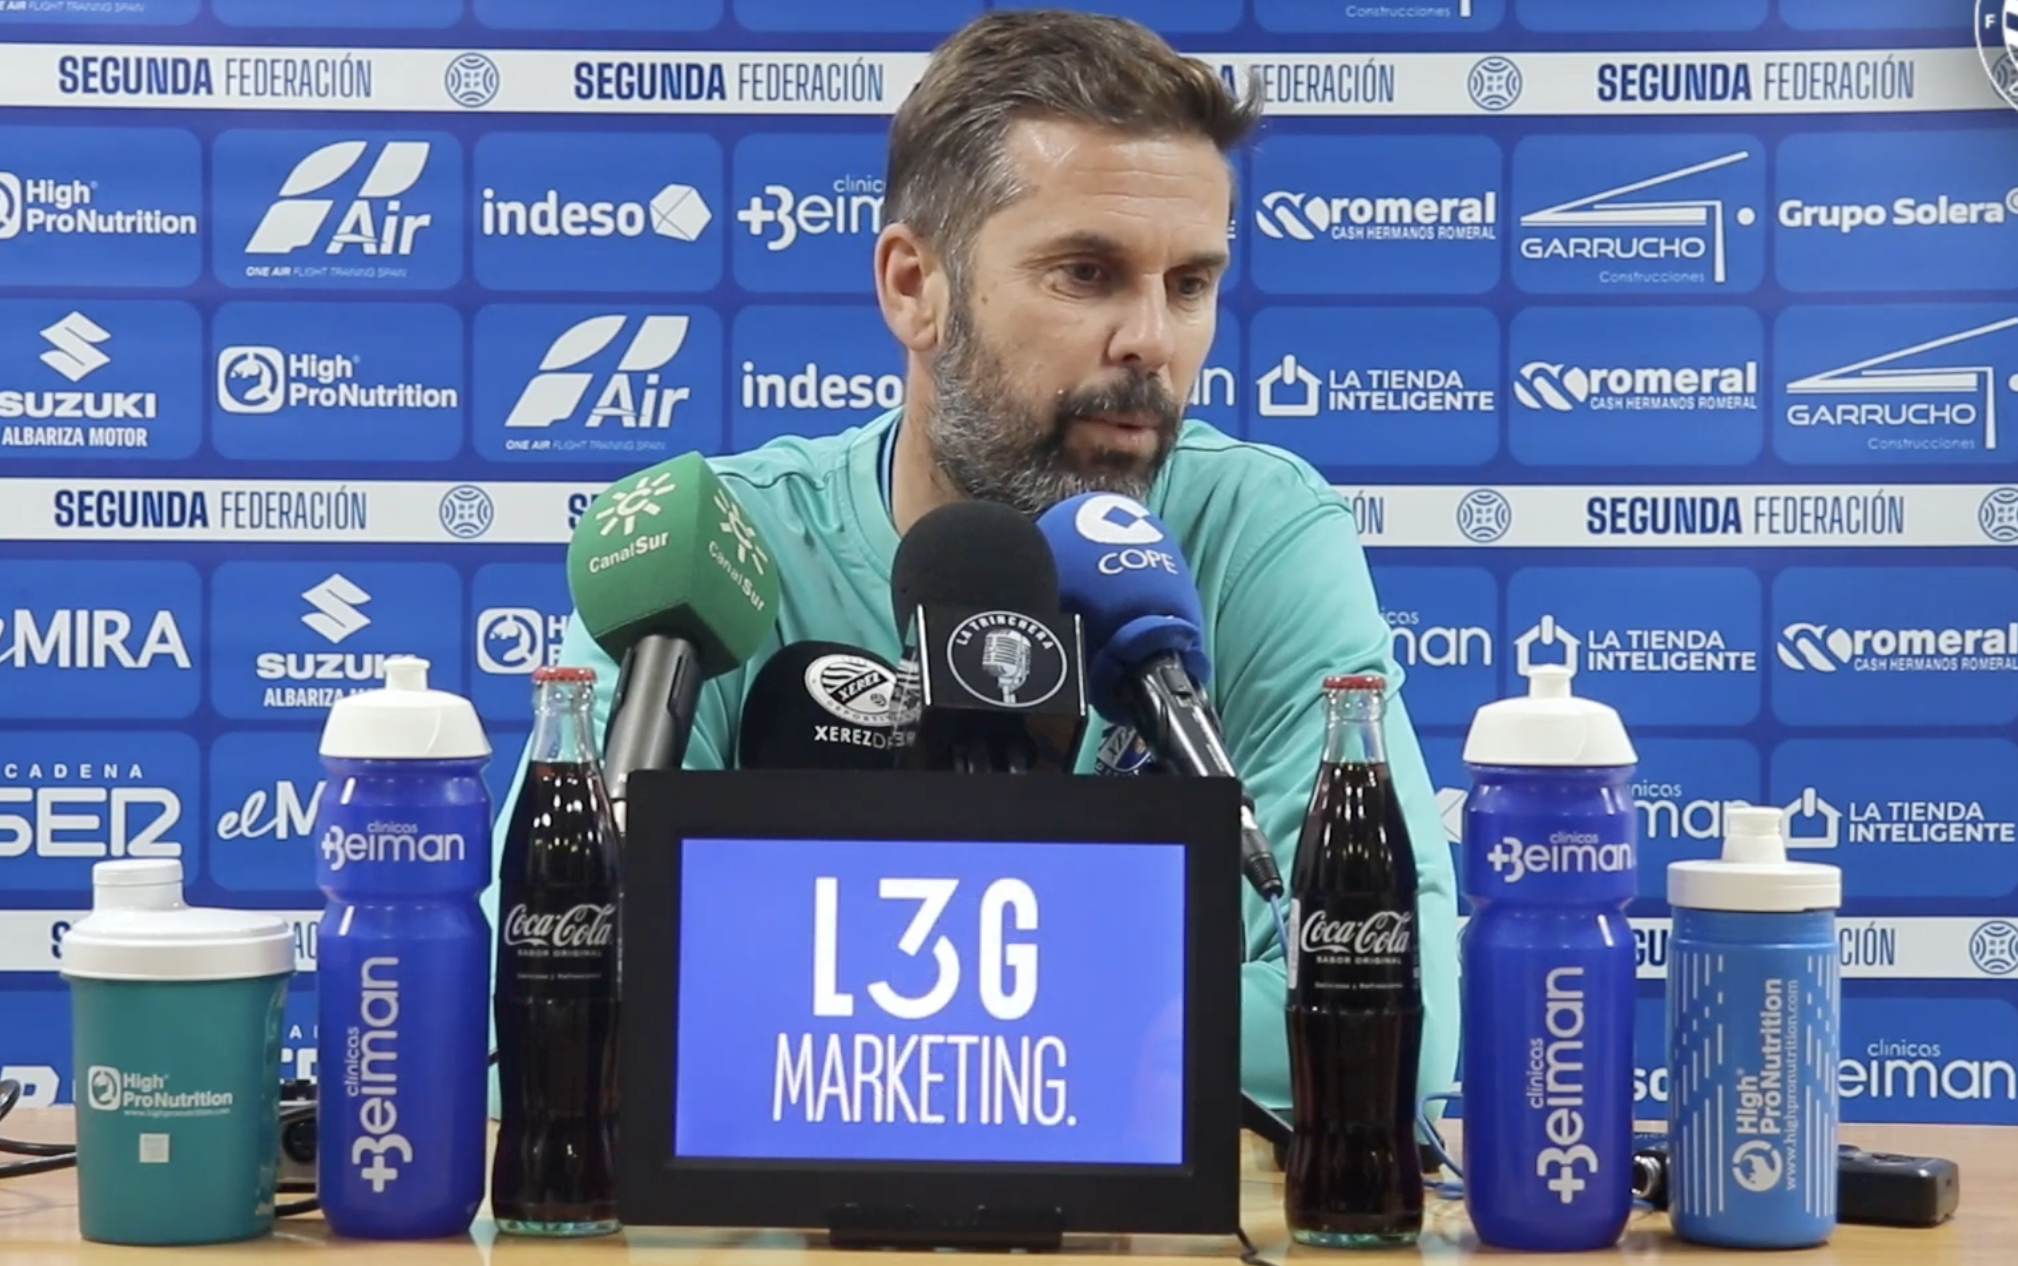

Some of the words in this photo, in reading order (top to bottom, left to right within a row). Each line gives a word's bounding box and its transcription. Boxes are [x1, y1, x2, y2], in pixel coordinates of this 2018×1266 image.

[1345, 6, 1451, 18] Construcciones
[58, 56, 213, 96] SEGUNDA
[226, 53, 372, 98] FEDERACIÓN
[574, 62, 727, 100] SEGUNDA
[738, 57, 884, 103] FEDERACIÓN
[1597, 63, 1752, 102] SEGUNDA
[1764, 54, 1914, 100] FEDERACIÓN
[26, 179, 91, 210] High
[833, 174, 886, 194] clinic
[26, 208, 197, 235] ProNutrition
[482, 188, 645, 237] indeso
[737, 184, 886, 251] Beim
[1331, 191, 1496, 224] romeral
[1778, 200, 1886, 233] Grupo
[1892, 195, 2004, 226] Solera
[326, 200, 431, 255] Air
[1331, 227, 1364, 240] CASH
[1367, 227, 1435, 240] HERMANOS
[1438, 227, 1496, 240] ROMERAL
[1520, 237, 1706, 259] GARRUCHO
[246, 266, 270, 277] ONE
[271, 266, 292, 277] AIR
[1599, 271, 1704, 284] Construcciones
[289, 354, 353, 384] High
[1329, 370, 1361, 389] LA
[1367, 370, 1463, 389] TIENDA
[1588, 362, 1757, 394] romeral
[289, 383, 458, 408] ProNutrition
[742, 361, 902, 410] indeso
[0, 391, 157, 418] SUZUKI
[584, 374, 690, 428] Air
[1329, 391, 1494, 411] INTELIGENTE
[1590, 397, 1623, 409] CASH
[1626, 397, 1695, 410] HERMANOS
[1698, 397, 1757, 410] ROMERAL
[1787, 404, 1976, 425] GARRUCHO
[2, 426, 85, 446] ALBARIZA
[88, 427, 148, 447] MOTOR
[505, 439, 530, 450] ONE
[531, 440, 551, 450] AIR
[1868, 438, 1975, 450] Construcciones
[54, 489, 209, 528] SEGUNDA
[221, 486, 366, 529] FEDERACIÓN
[1586, 496, 1742, 535] SEGUNDA
[1754, 489, 1904, 535] FEDERACIÓN
[588, 532, 669, 573] CanalSur
[1098, 548, 1178, 576] COPE
[708, 541, 765, 611] CanalSur
[1588, 631, 1622, 649] LA
[1628, 631, 1725, 650] TIENDA
[1854, 623, 2018, 655] romeral
[256, 652, 386, 680] SUZU
[1588, 652, 1756, 671] INTELIGENTE
[1854, 658, 1887, 671] CASH
[1890, 658, 1958, 671] HERMANOS
[1961, 658, 2018, 671] ROMERAL
[838, 672, 880, 701] XEREZ
[5, 763, 143, 779] CADENA
[1849, 803, 1882, 821] LA
[1887, 803, 1983, 822] TIENDA
[1849, 824, 2015, 843] INTELIGENTE
[503, 903, 616, 947] Coca-Cola
[1300, 910, 1413, 954] Coca-Cola
[813, 876, 1039, 1020] L3G
[1760, 978, 1782, 1134] ProNutrition
[122, 1072, 164, 1092] High
[773, 1033, 1077, 1127] MARKETING.
[1838, 1058, 2017, 1099] eiman
[123, 1091, 233, 1108] ProNutrition
